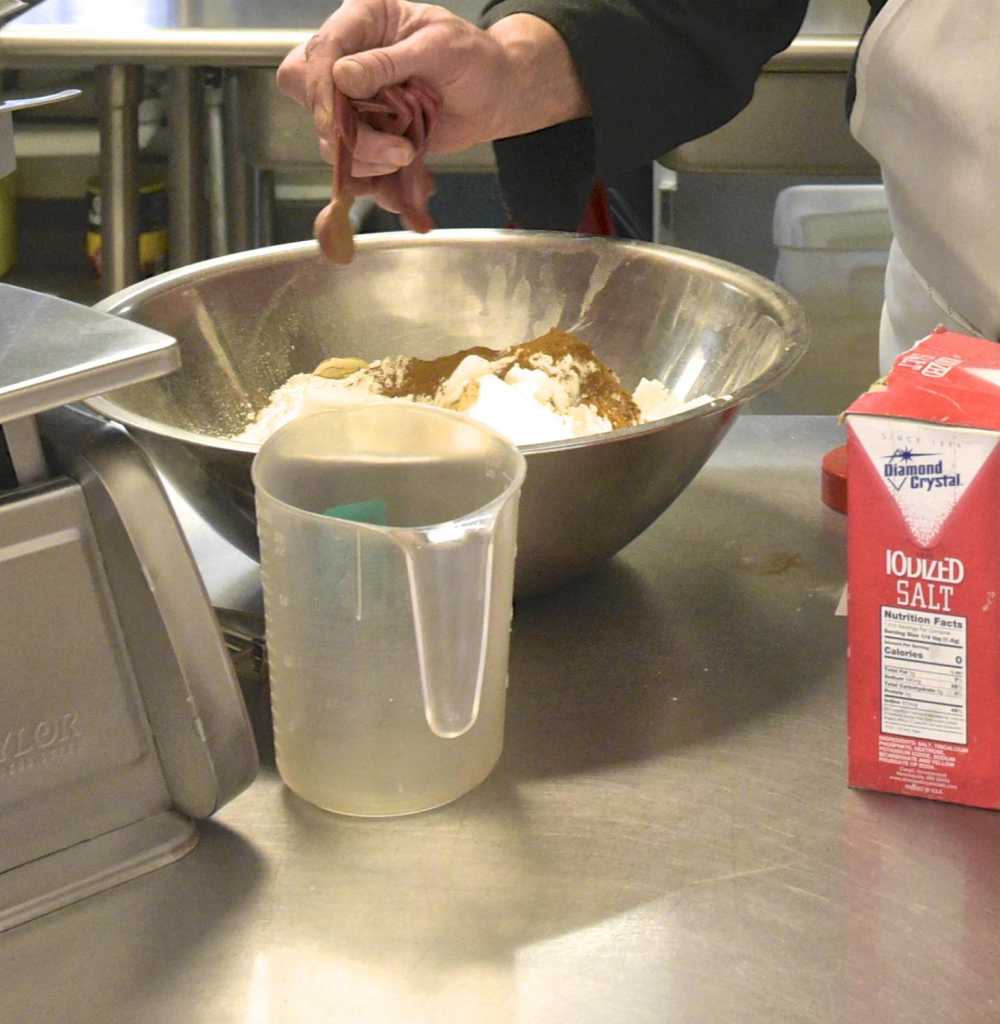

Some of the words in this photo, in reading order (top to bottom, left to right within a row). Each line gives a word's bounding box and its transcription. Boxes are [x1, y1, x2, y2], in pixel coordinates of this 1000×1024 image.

[884, 459, 944, 477] Diamond
[910, 473, 961, 493] Crystal
[885, 548, 965, 585] IODIZED
[896, 579, 954, 612] SALT
[884, 610, 931, 625] Nutrition
[934, 617, 963, 629] Facts
[884, 646, 924, 660] Calories
[955, 655, 963, 665] 0
